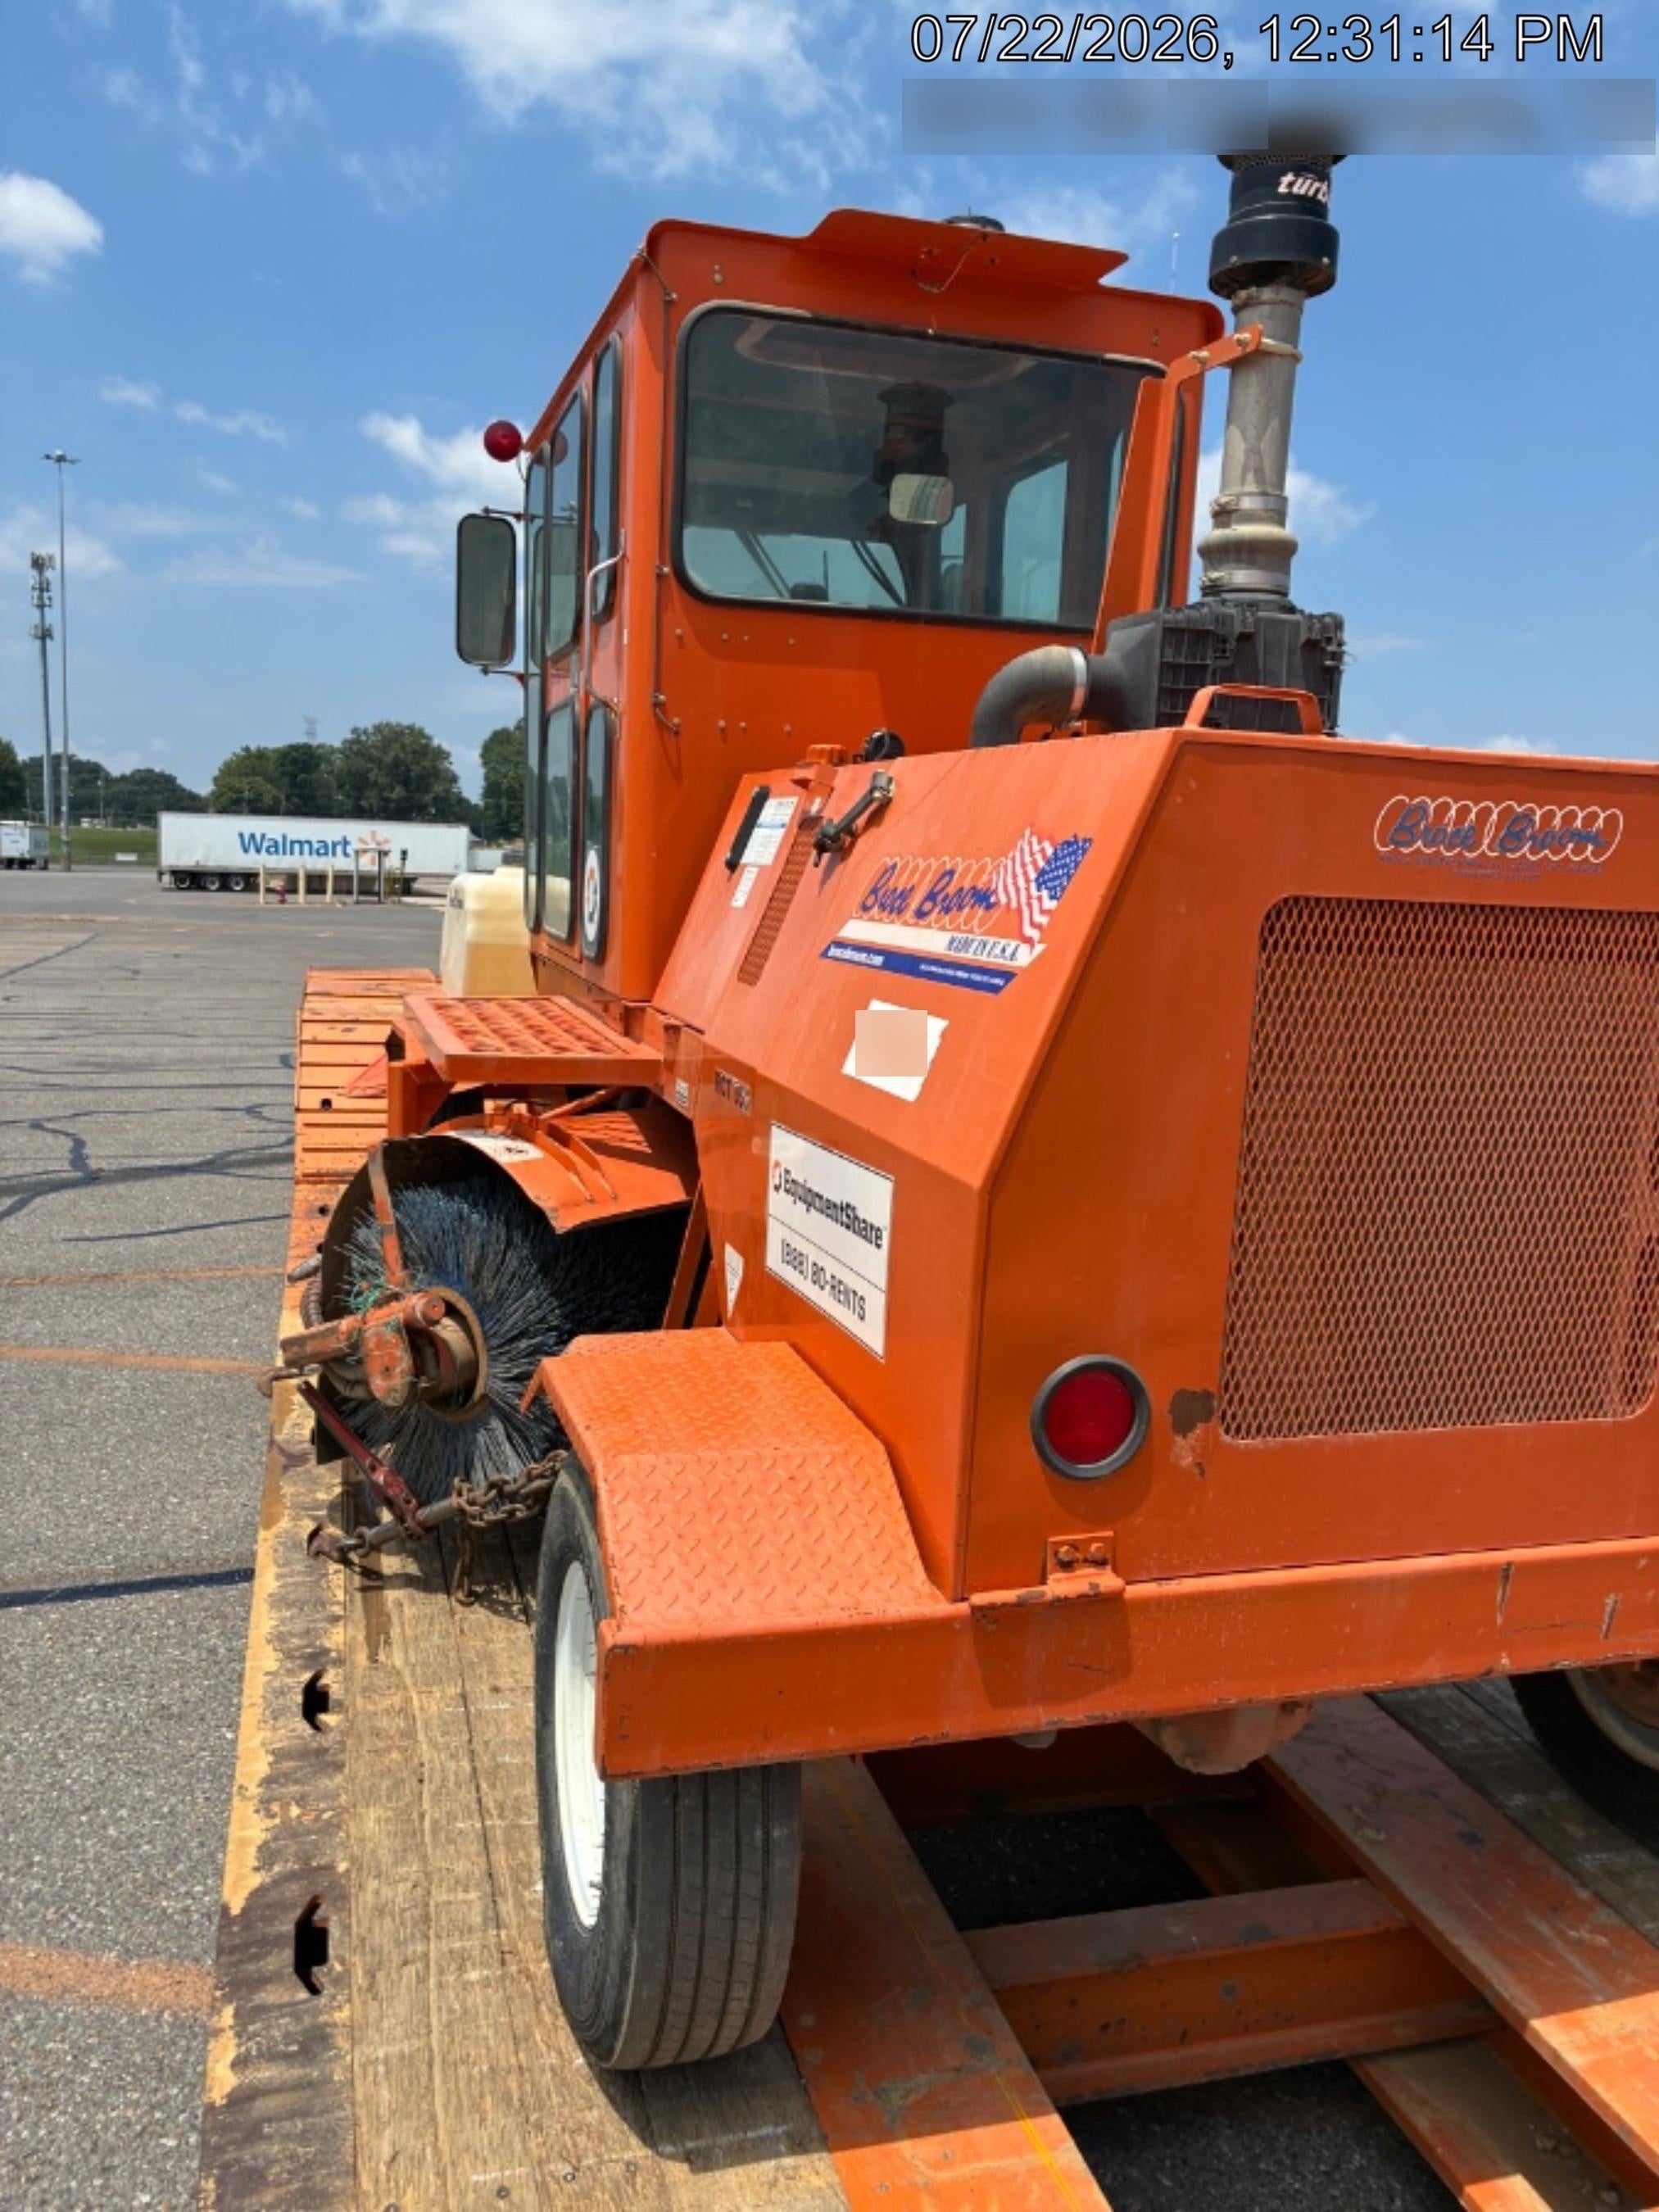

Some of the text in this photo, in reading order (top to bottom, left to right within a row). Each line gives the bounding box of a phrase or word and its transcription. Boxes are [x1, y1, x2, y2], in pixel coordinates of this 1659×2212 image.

[238, 831, 352, 859] Walmart
[783, 1167, 883, 1249] EquipmentShare
[781, 1238, 809, 1281] (888)
[810, 1261, 866, 1321] 80-RENTS
